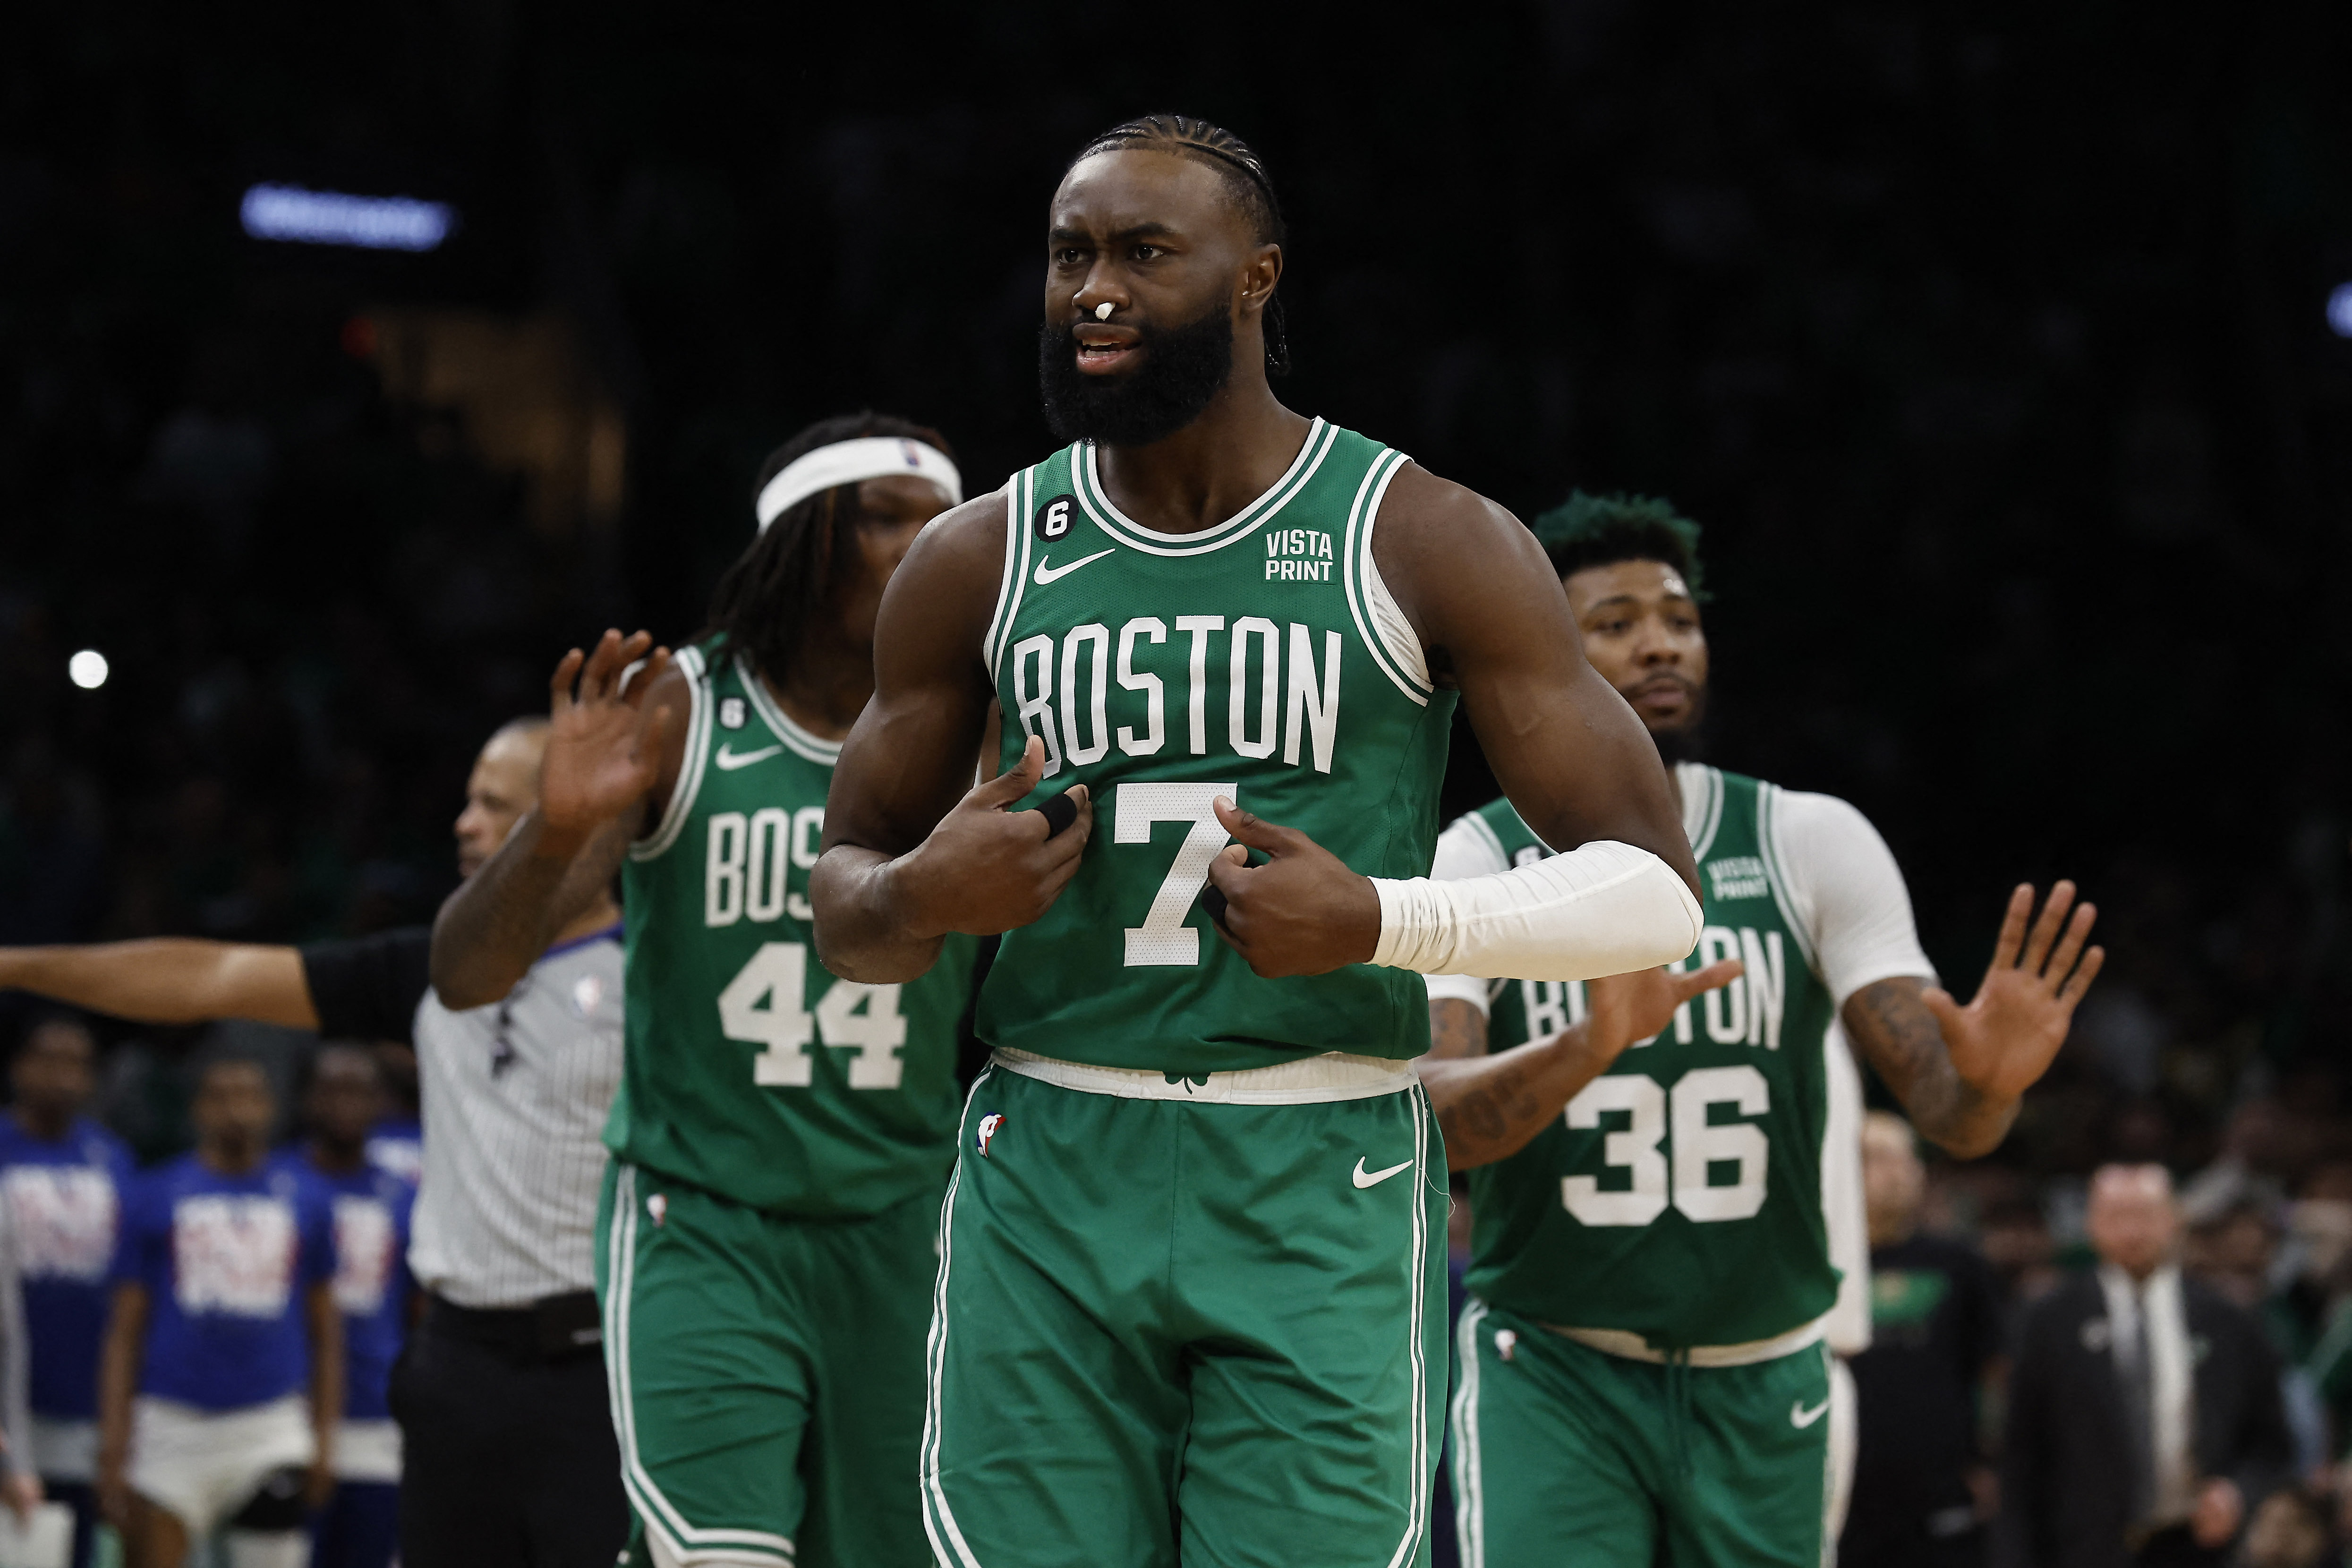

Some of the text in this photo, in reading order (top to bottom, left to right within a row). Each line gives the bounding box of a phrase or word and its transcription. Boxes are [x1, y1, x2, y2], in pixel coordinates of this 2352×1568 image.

[1045, 501, 1069, 537] 6
[1266, 529, 1333, 560] VISTA
[1266, 560, 1333, 581] PRINT
[1014, 615, 1342, 779] BOSTON
[705, 807, 825, 927] BOS
[1115, 782, 1237, 966] 7
[718, 942, 907, 1090] 44
[1560, 1065, 1770, 1227] 36
